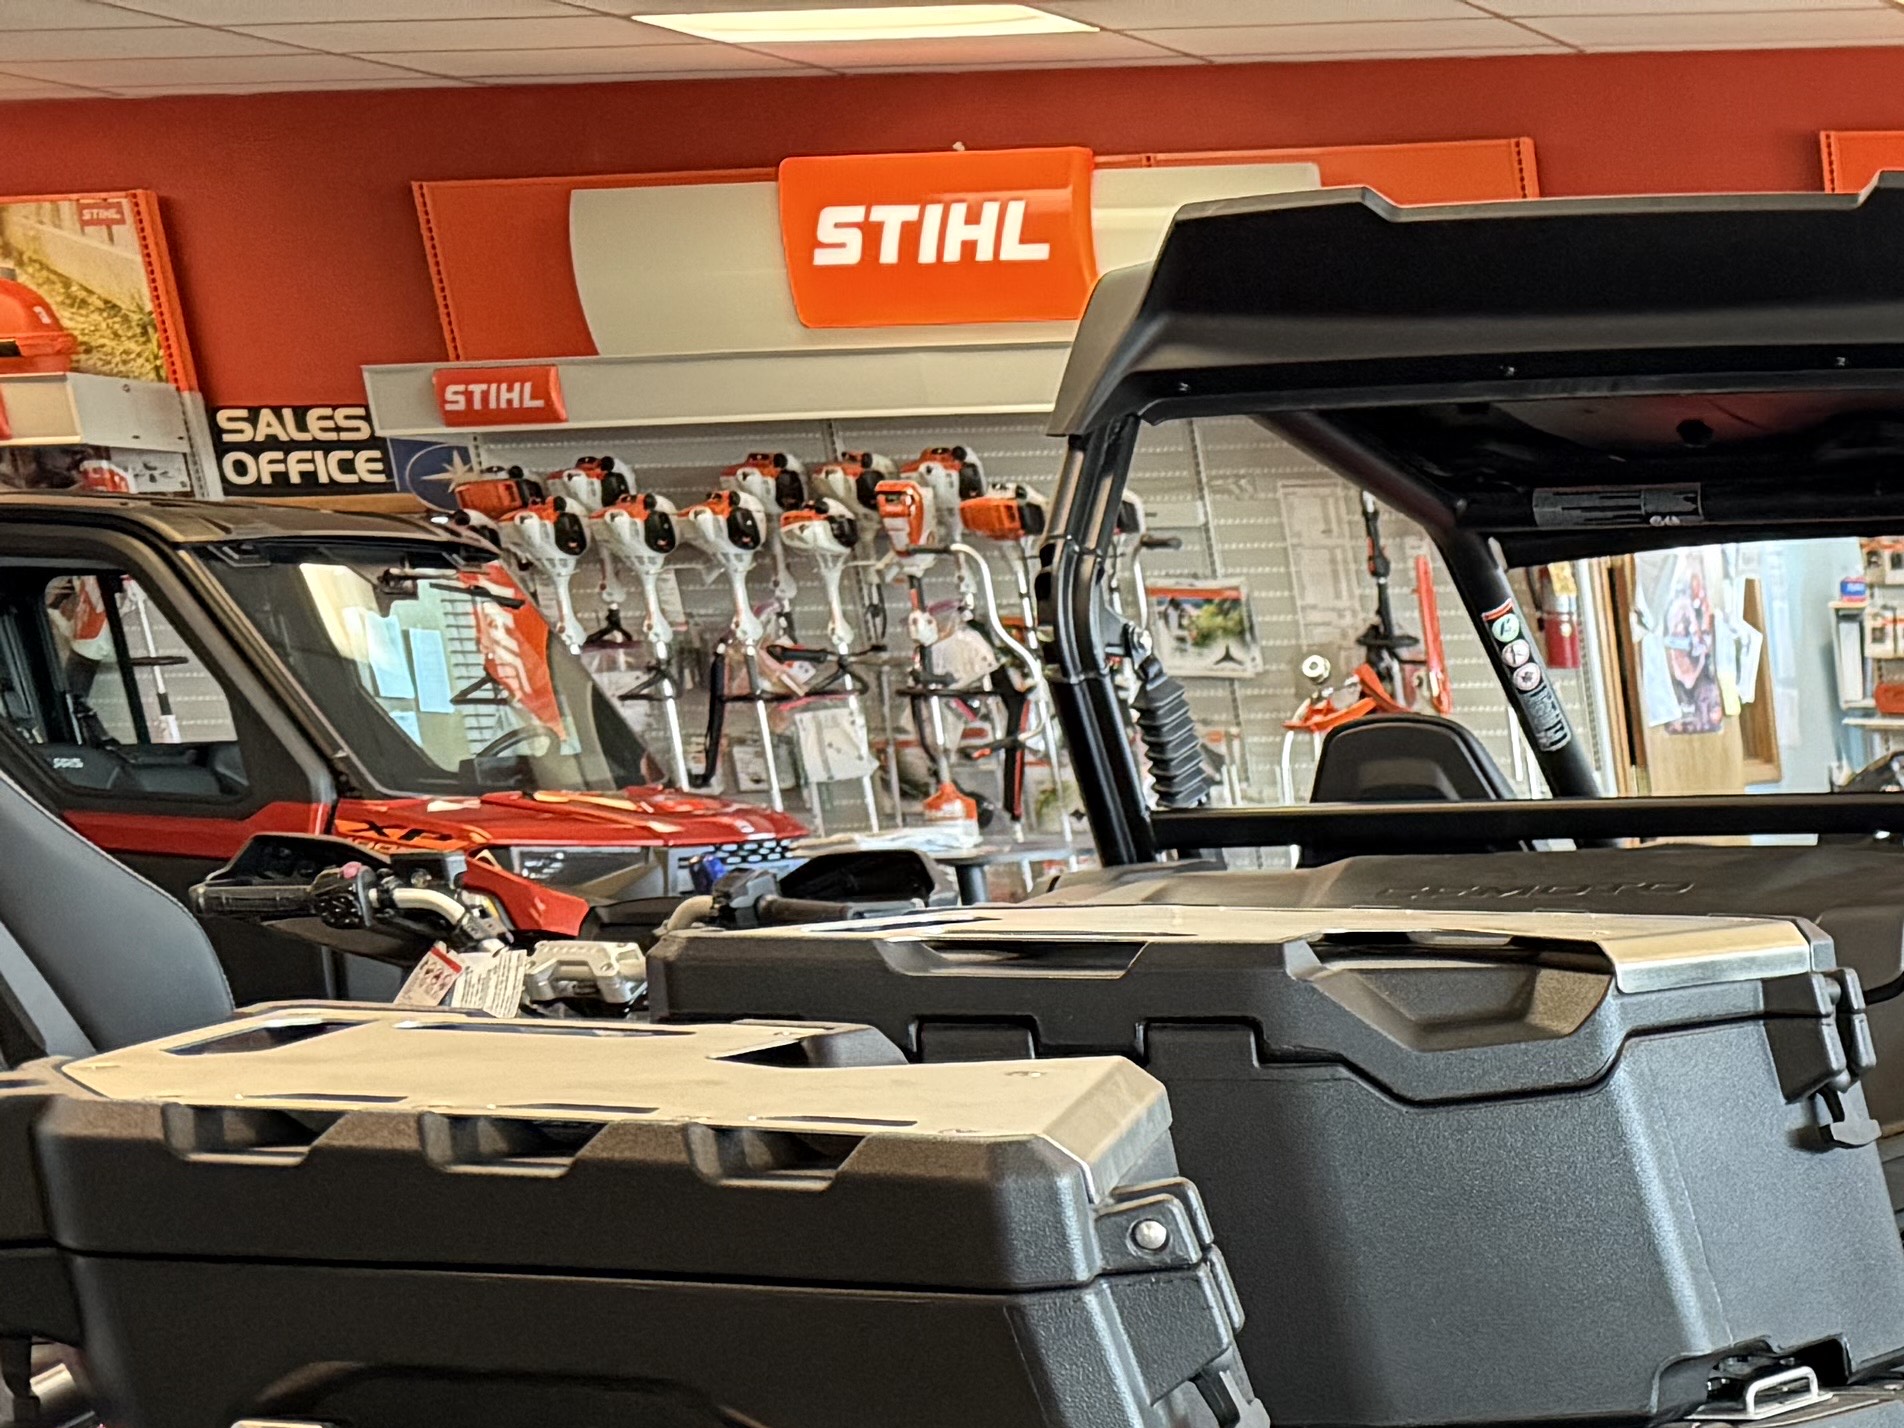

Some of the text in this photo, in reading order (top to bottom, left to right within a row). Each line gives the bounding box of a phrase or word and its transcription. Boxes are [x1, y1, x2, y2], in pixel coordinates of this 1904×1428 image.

[82, 207, 121, 221] STIHL
[813, 199, 1051, 267] STIHL
[444, 382, 545, 411] STIHL
[217, 407, 372, 442] SALES
[221, 448, 387, 486] OFFICE
